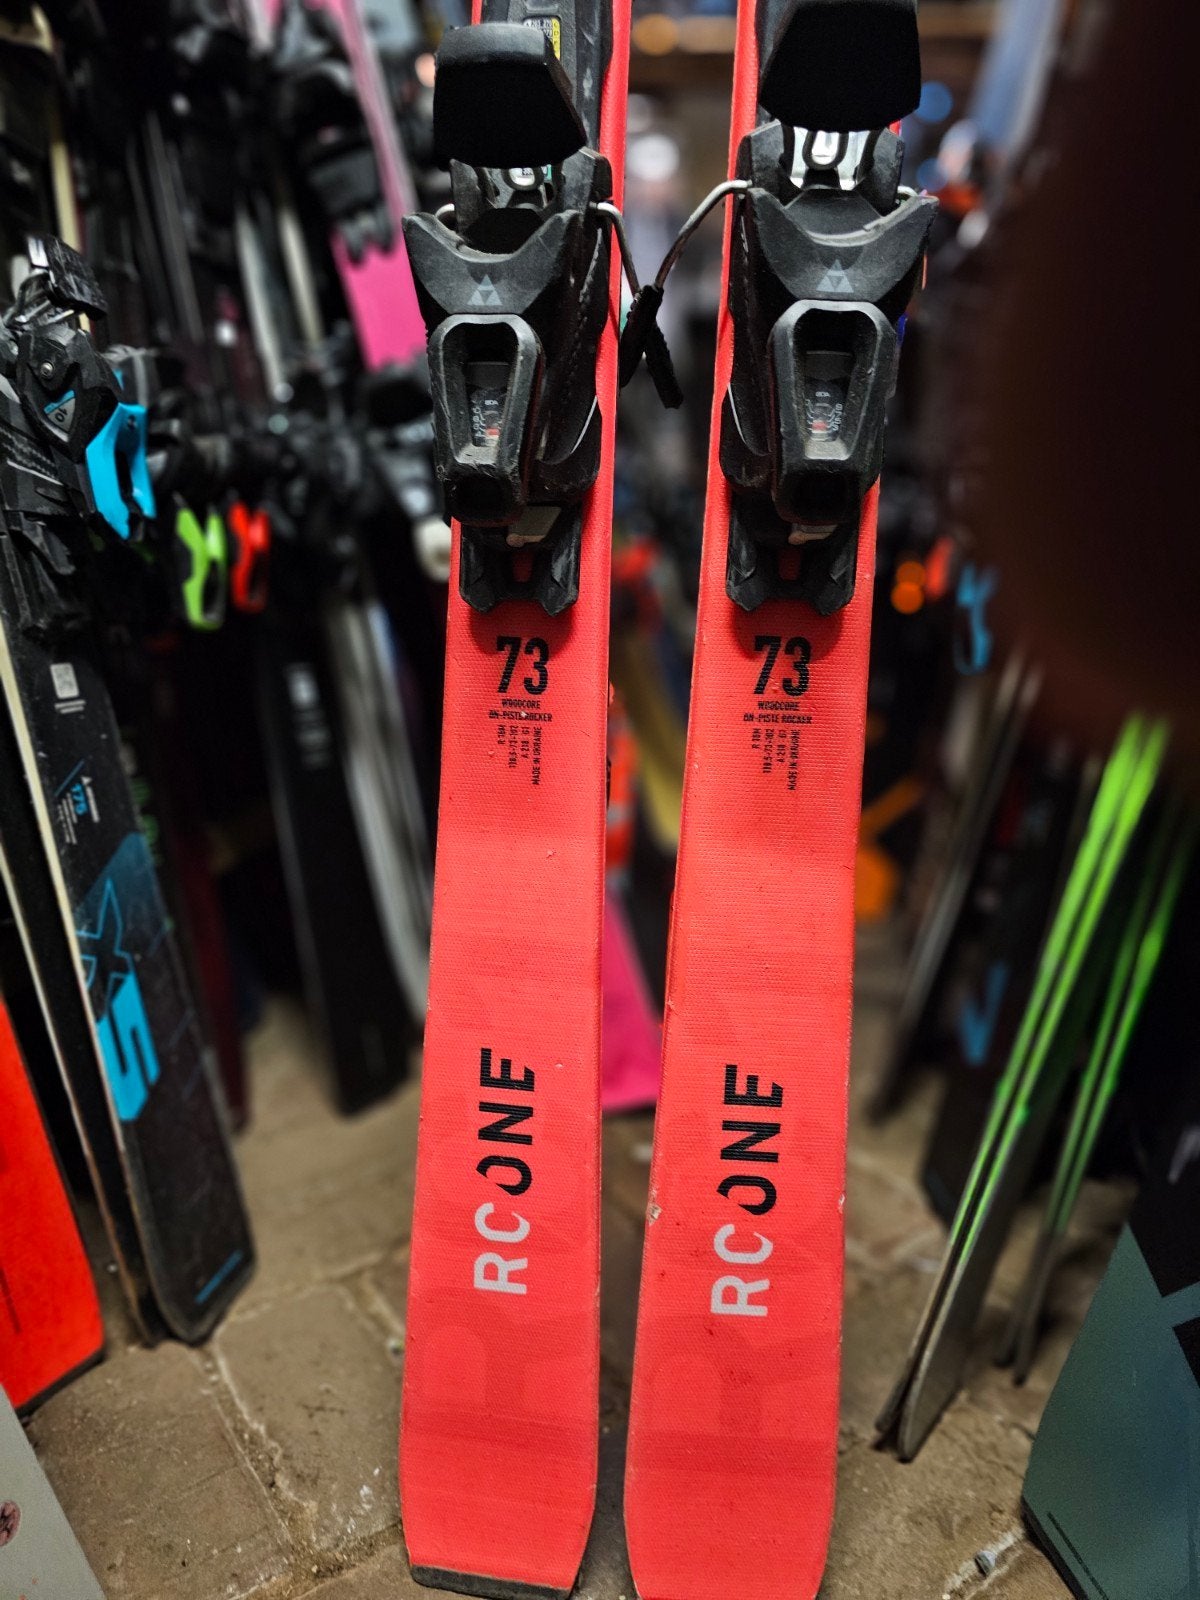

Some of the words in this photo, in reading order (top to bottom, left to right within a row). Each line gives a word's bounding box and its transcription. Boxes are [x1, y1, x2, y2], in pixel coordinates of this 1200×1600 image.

[55, 408, 68, 423] 10
[496, 635, 549, 696] 73
[753, 635, 811, 697] 73
[501, 698, 541, 709] WOODCORE
[532, 726, 542, 756] UKRAINE
[531, 766, 541, 786] MADE
[476, 1047, 536, 1196] ONE
[716, 1064, 784, 1217] ONE
[473, 1202, 531, 1295] RC
[710, 1223, 774, 1317] RC
